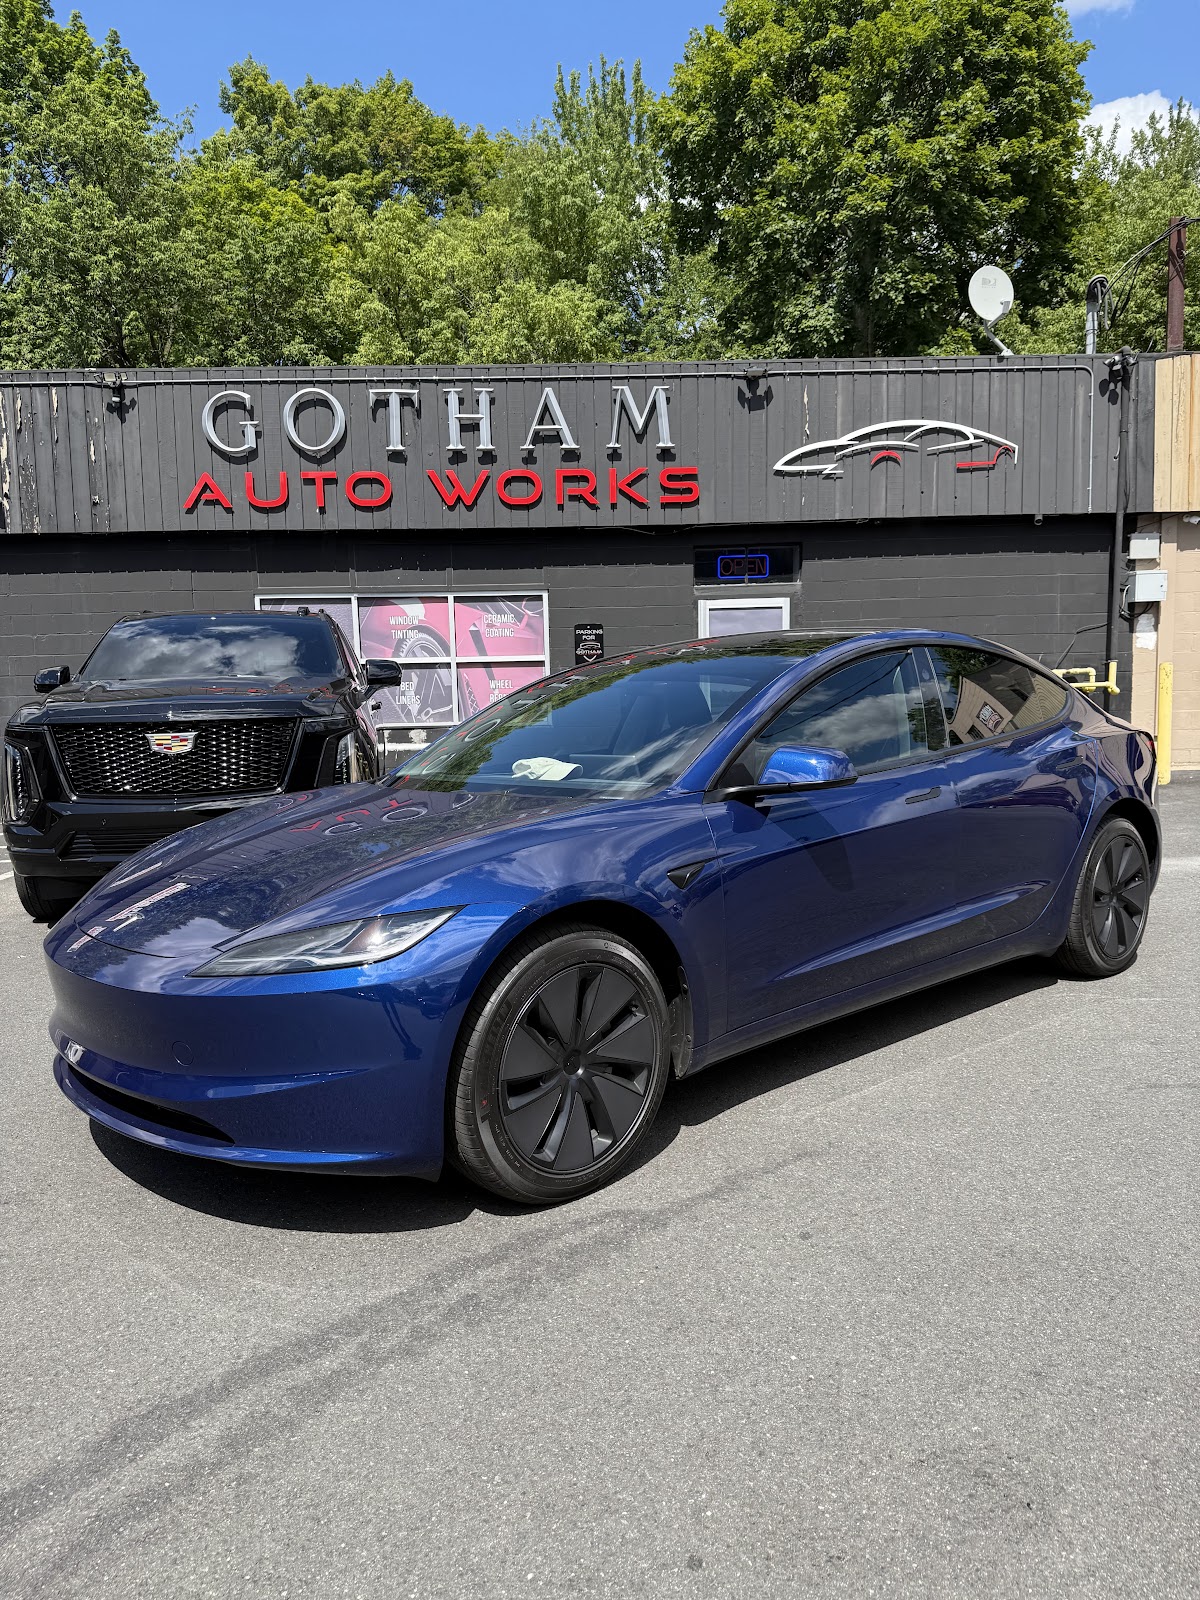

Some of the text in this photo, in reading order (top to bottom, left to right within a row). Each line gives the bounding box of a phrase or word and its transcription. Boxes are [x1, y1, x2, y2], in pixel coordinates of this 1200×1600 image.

[201, 385, 676, 454] GOTHAM
[184, 466, 700, 508] AUTO WORKS
[720, 558, 767, 575] OPEN
[389, 616, 419, 625] WINDOW
[483, 614, 515, 624] CERAMIC
[391, 629, 419, 639] TINTING
[485, 628, 514, 638] COATING
[400, 681, 415, 691] BED
[489, 679, 513, 689] WHEEL
[395, 695, 421, 705] LINERS
[489, 693, 508, 703] REP
